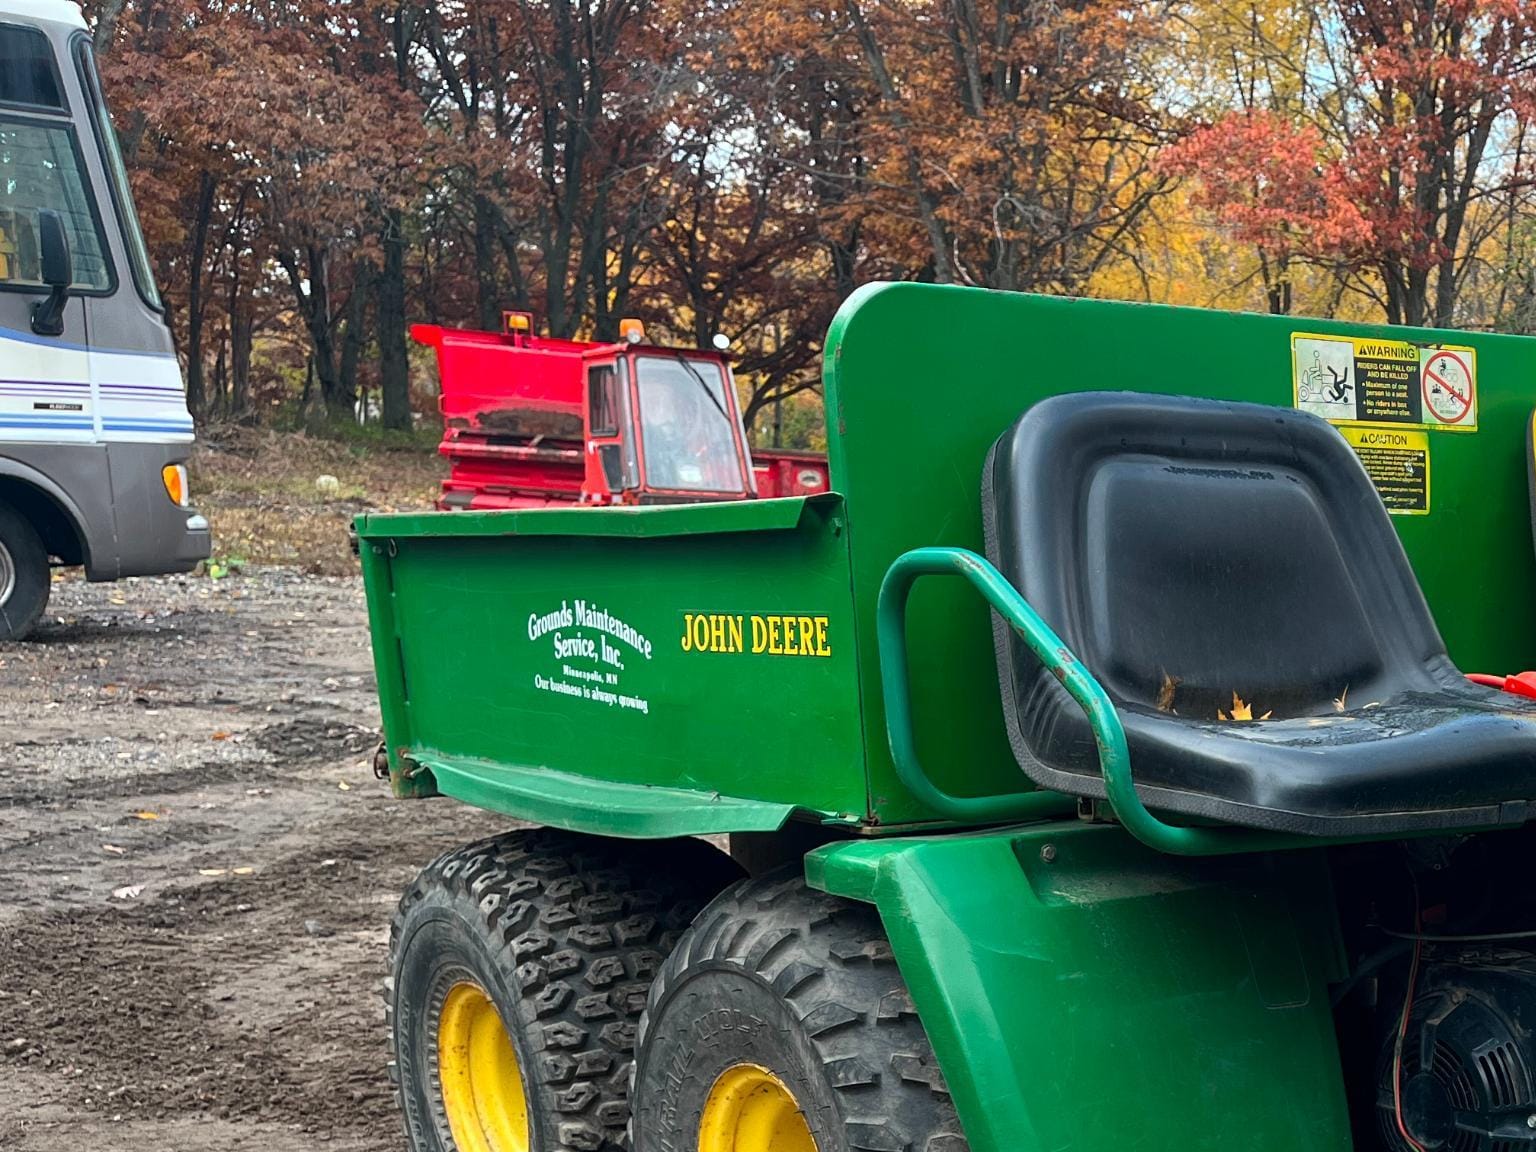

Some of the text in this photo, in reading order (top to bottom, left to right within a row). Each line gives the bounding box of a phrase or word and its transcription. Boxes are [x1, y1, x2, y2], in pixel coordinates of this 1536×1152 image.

[1367, 345, 1415, 359] WARNING
[1357, 362, 1417, 373] RIDERS CAN FALL OFF
[1367, 370, 1409, 380] AND BE KILLED
[1365, 381, 1391, 389] Maximum
[1373, 408, 1399, 416] anywhere
[1369, 433, 1408, 445] CAUTION
[528, 600, 653, 660] Grounds Maintenance
[681, 614, 832, 657] JOHN DEERE
[554, 632, 625, 671] Service, Inc.
[562, 664, 618, 686] Minneapolis, MN
[534, 674, 649, 715] Our business is always growing
